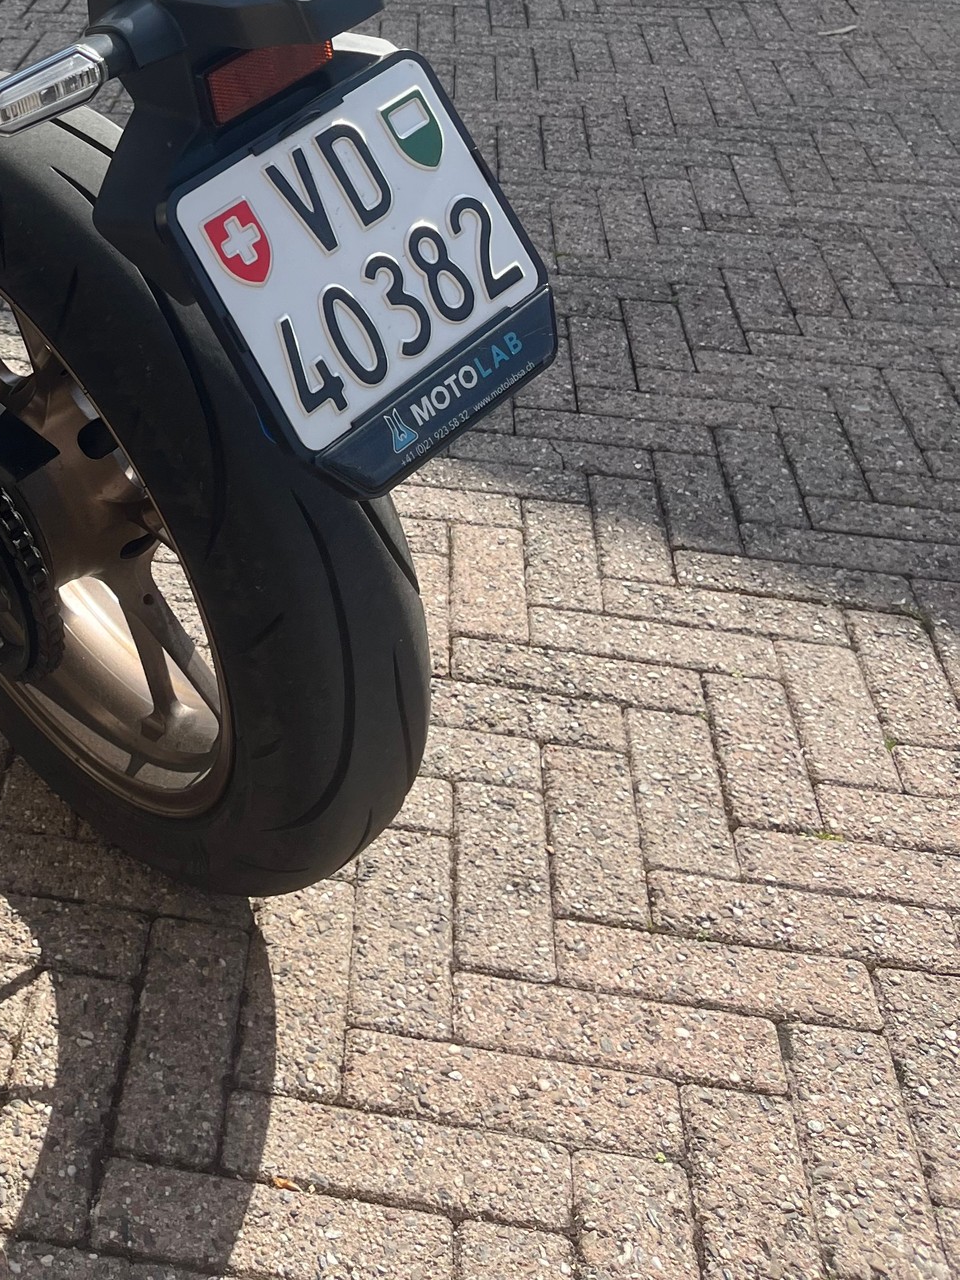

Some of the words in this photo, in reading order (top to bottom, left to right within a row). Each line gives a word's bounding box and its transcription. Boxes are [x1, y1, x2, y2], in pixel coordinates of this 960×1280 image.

[264, 122, 392, 253] VD
[279, 196, 525, 415] 40382
[401, 452, 416, 466] +41
[416, 437, 434, 457] (0)21
[434, 426, 449, 440] 923
[449, 417, 460, 431] 58
[459, 410, 470, 422] 32
[473, 361, 535, 412] www.motolabsa.ch
[409, 332, 523, 426] MOTOLAB
